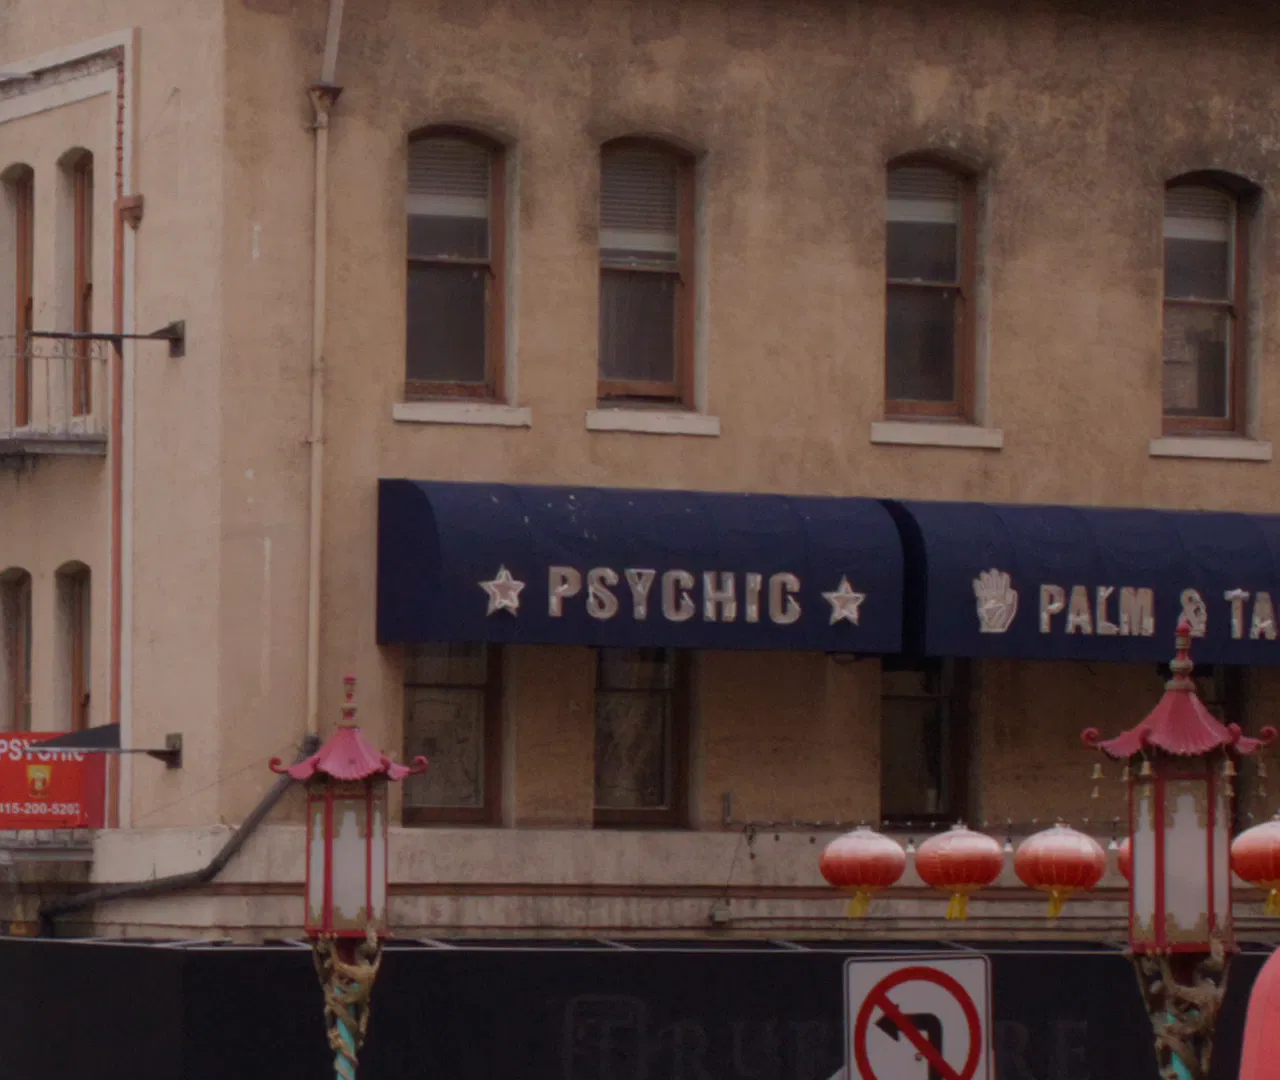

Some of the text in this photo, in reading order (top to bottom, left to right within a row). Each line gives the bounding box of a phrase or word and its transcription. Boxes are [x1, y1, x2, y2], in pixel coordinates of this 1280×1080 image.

[547, 565, 802, 625] PSYCHIC
[1039, 583, 1279, 640] PALM & TA
